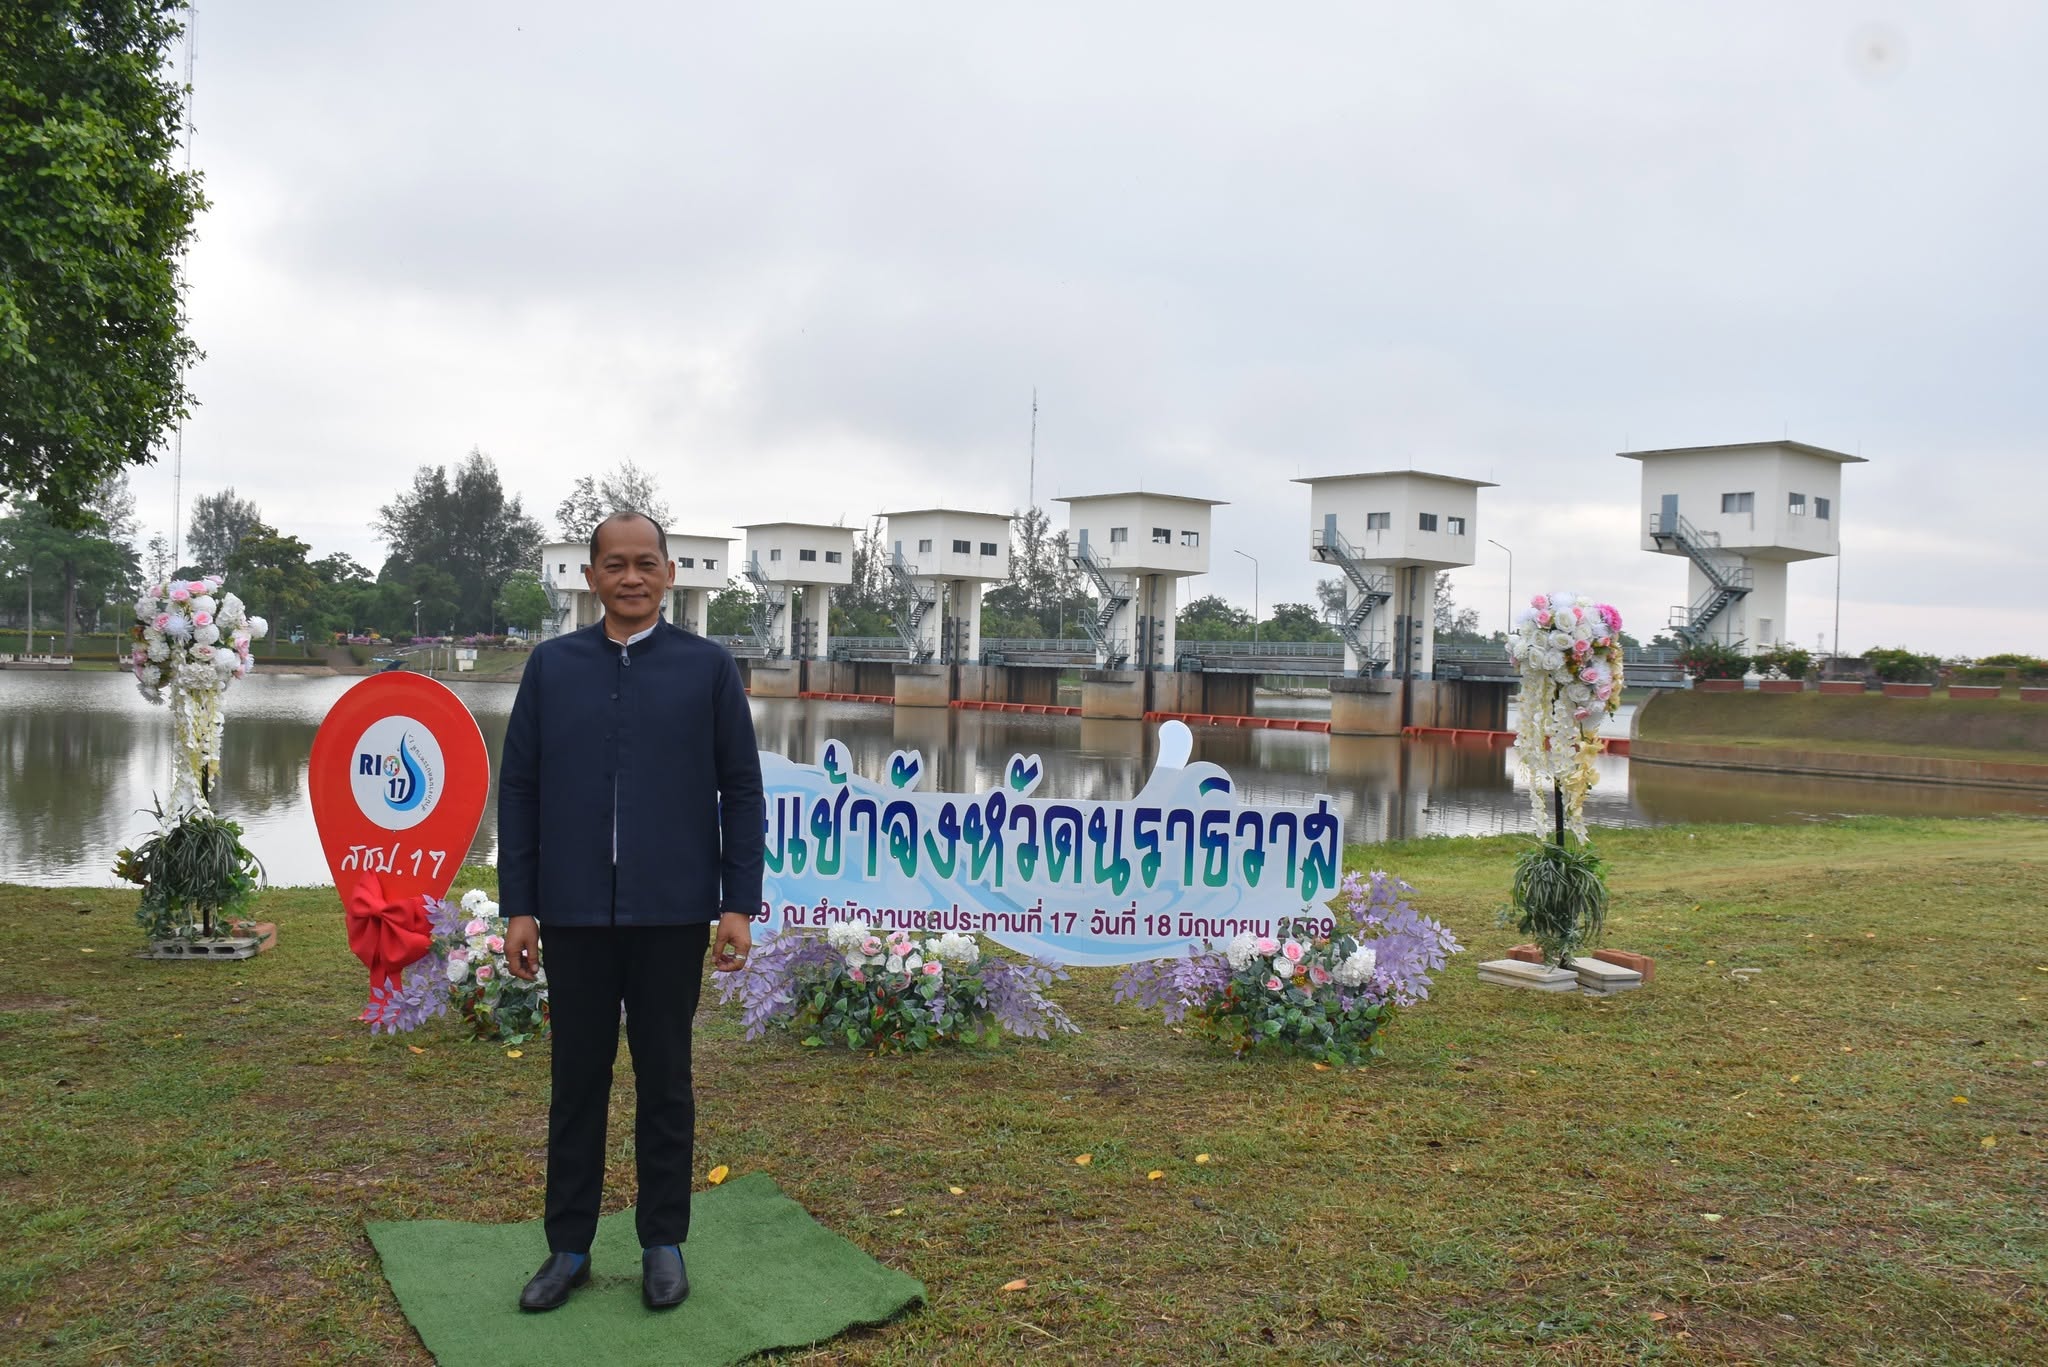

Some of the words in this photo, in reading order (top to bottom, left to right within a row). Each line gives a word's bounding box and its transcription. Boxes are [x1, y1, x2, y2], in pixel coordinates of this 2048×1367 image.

[388, 777, 406, 799] 17
[341, 843, 402, 875] สชป.
[410, 849, 446, 879] 17
[783, 905, 805, 926] ณ
[813, 898, 1042, 934] สำนักงานชลประทานที่
[1050, 912, 1078, 934] 17
[1090, 901, 1136, 936] วันที่
[1144, 914, 1172, 937] 18
[1178, 912, 1270, 945] มิถุนายน
[1277, 916, 1334, 940] 2569
